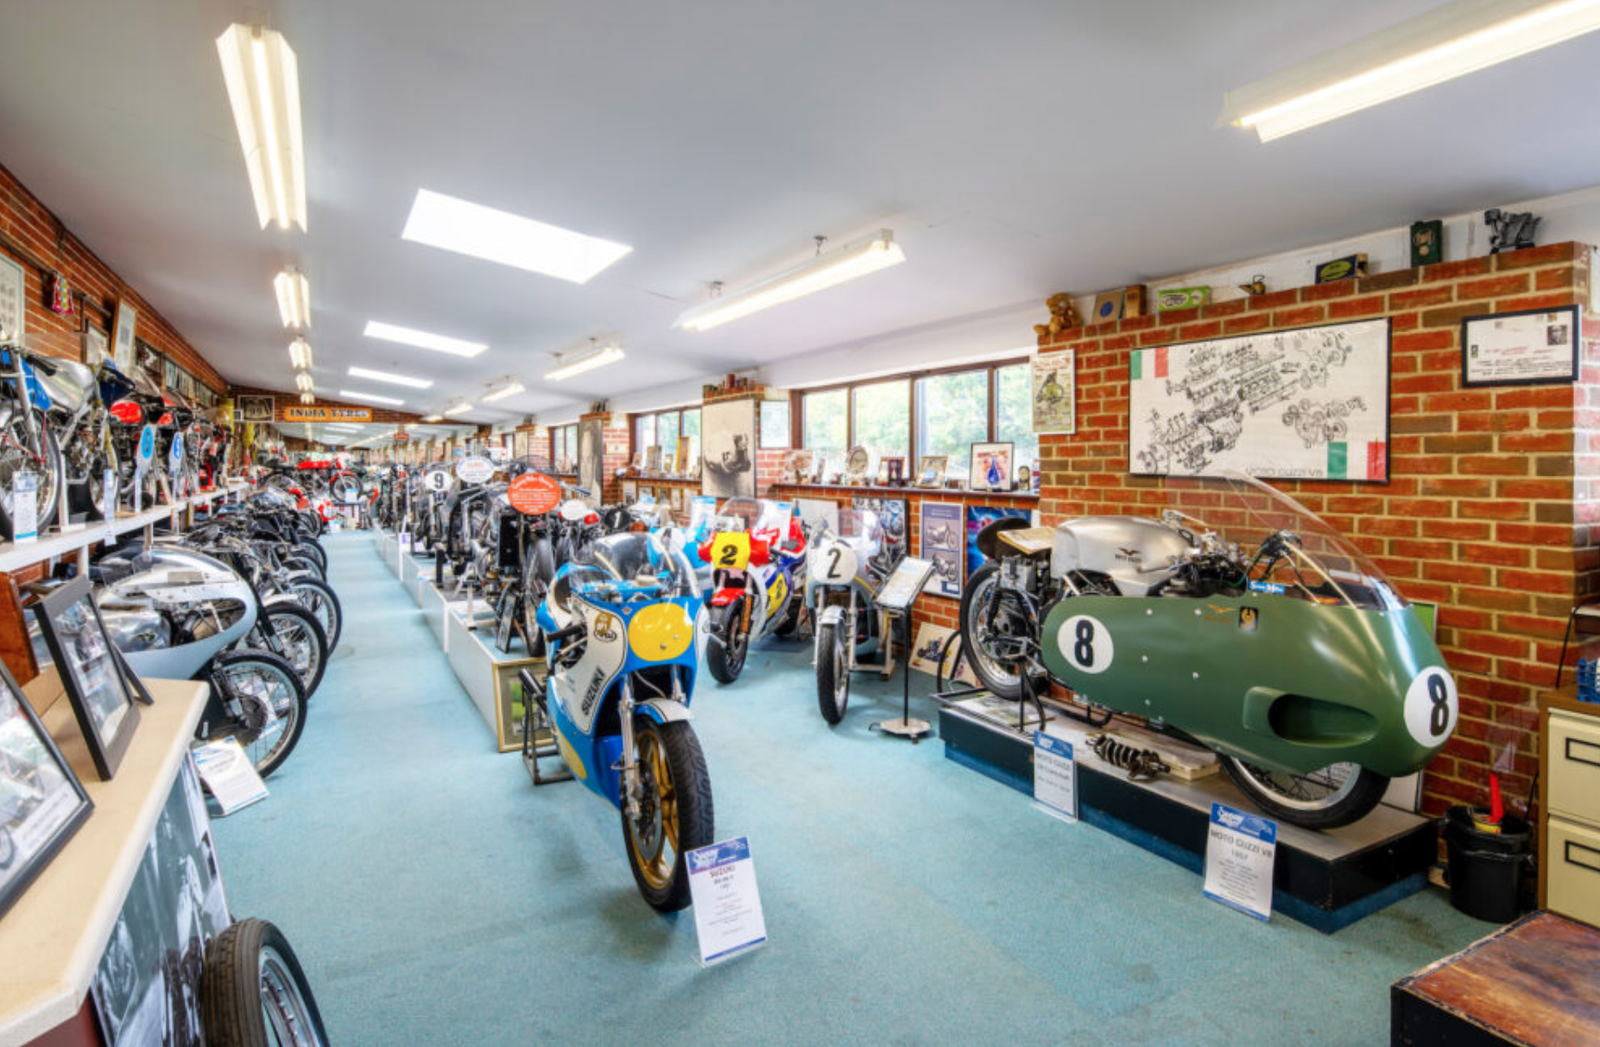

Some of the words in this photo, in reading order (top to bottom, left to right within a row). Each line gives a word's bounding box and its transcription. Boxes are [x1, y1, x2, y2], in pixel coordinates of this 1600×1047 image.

[290, 408, 326, 417] INDIA
[434, 472, 444, 489] 9
[614, 510, 622, 529] 1
[720, 544, 739, 566] 2
[827, 547, 842, 579] 2
[1074, 619, 1094, 668] 8
[582, 666, 606, 716] SUZUKI
[1427, 673, 1450, 737] 8
[1211, 829, 1234, 844] MOTO
[1236, 839, 1260, 853] GUZZI
[1261, 847, 1273, 858] V8
[709, 864, 736, 878] SUZUKI
